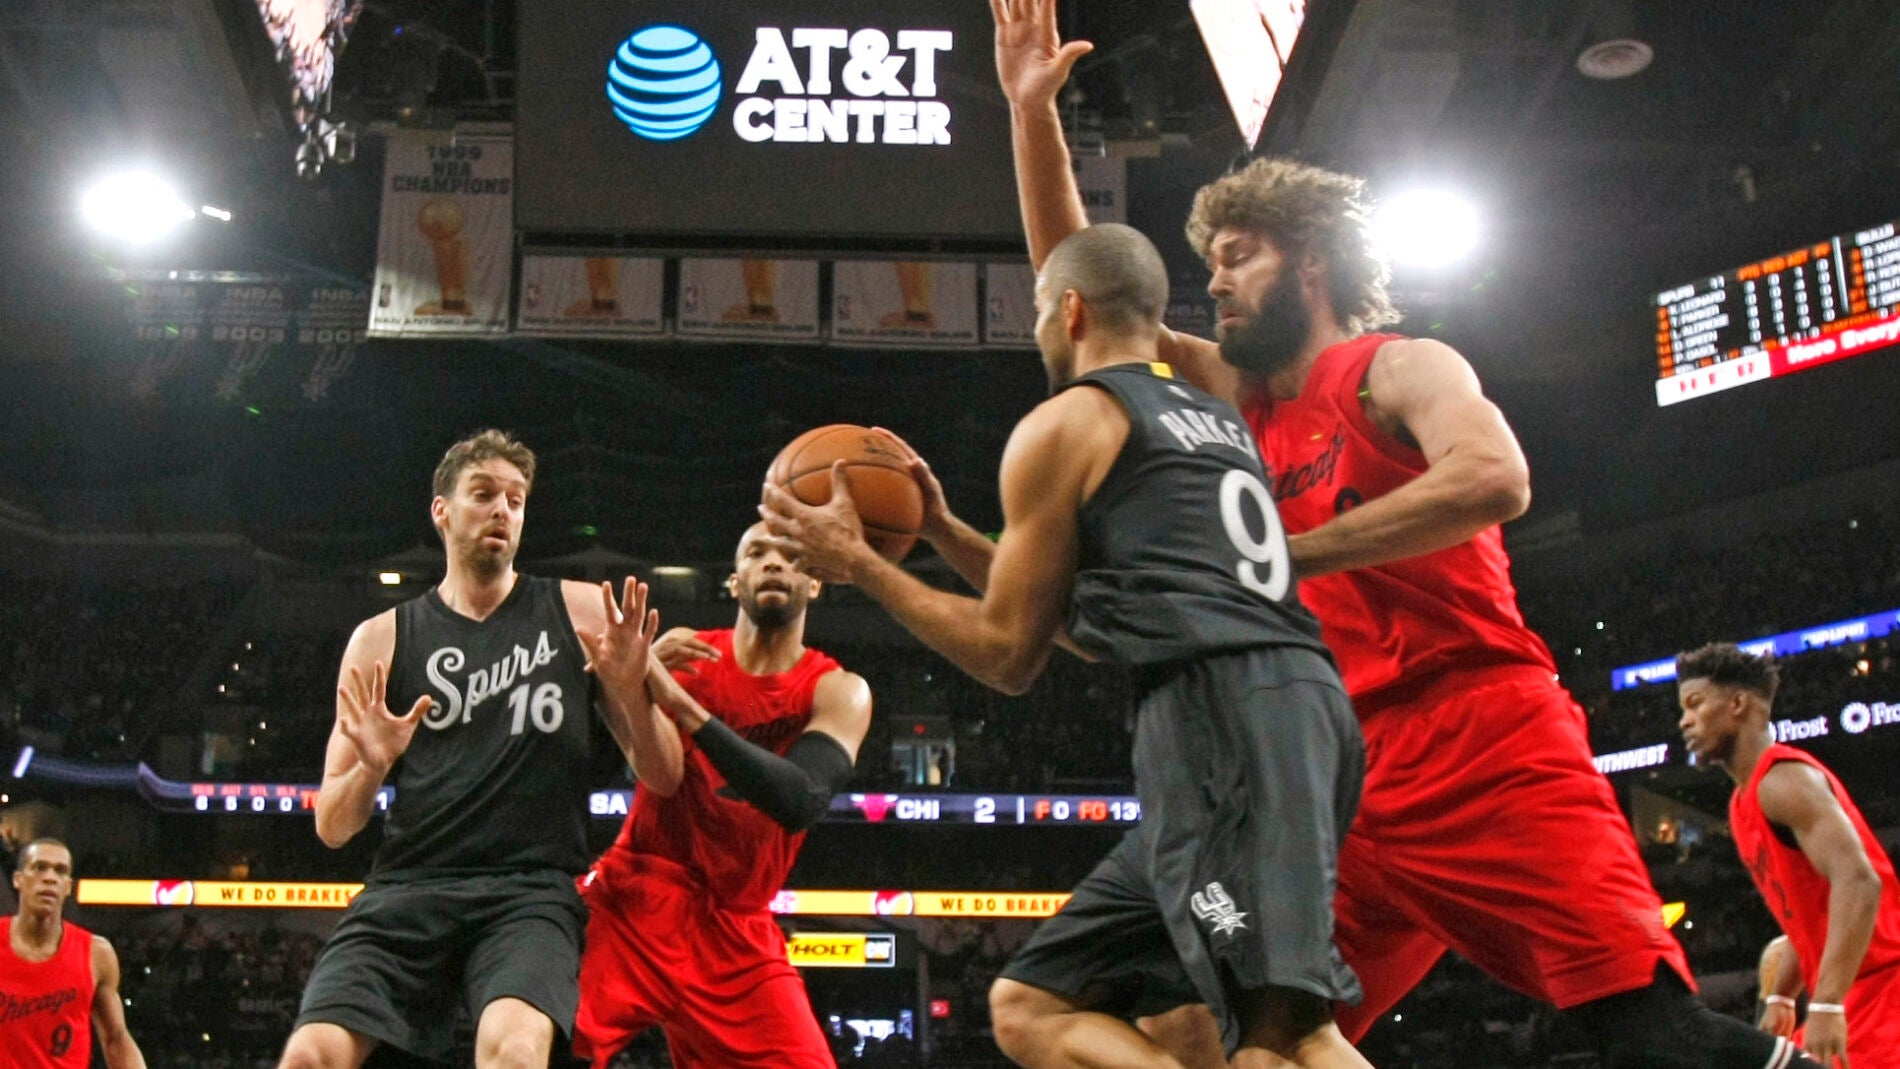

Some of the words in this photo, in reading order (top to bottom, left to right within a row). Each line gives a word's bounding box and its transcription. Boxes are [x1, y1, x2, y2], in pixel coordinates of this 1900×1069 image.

[735, 27, 953, 97] AT&T
[732, 97, 952, 145] CENTER
[392, 175, 511, 194] CHAMPIONS
[1219, 469, 1290, 602] 9
[421, 630, 559, 731] Spurs
[507, 682, 564, 736] 16
[1777, 715, 1829, 743] Frost
[252, 797, 265, 812] 0
[279, 797, 293, 812] 0
[895, 799, 940, 820] CHI
[973, 797, 996, 823] 2
[1034, 800, 1050, 821] F
[1052, 801, 1070, 821] 0
[1077, 801, 1108, 822] FG
[221, 888, 243, 900] WE
[254, 888, 277, 901] DO
[940, 898, 964, 911] WE
[974, 899, 997, 912] DO
[792, 943, 856, 957] HOLT
[50, 1022, 73, 1058] 9
